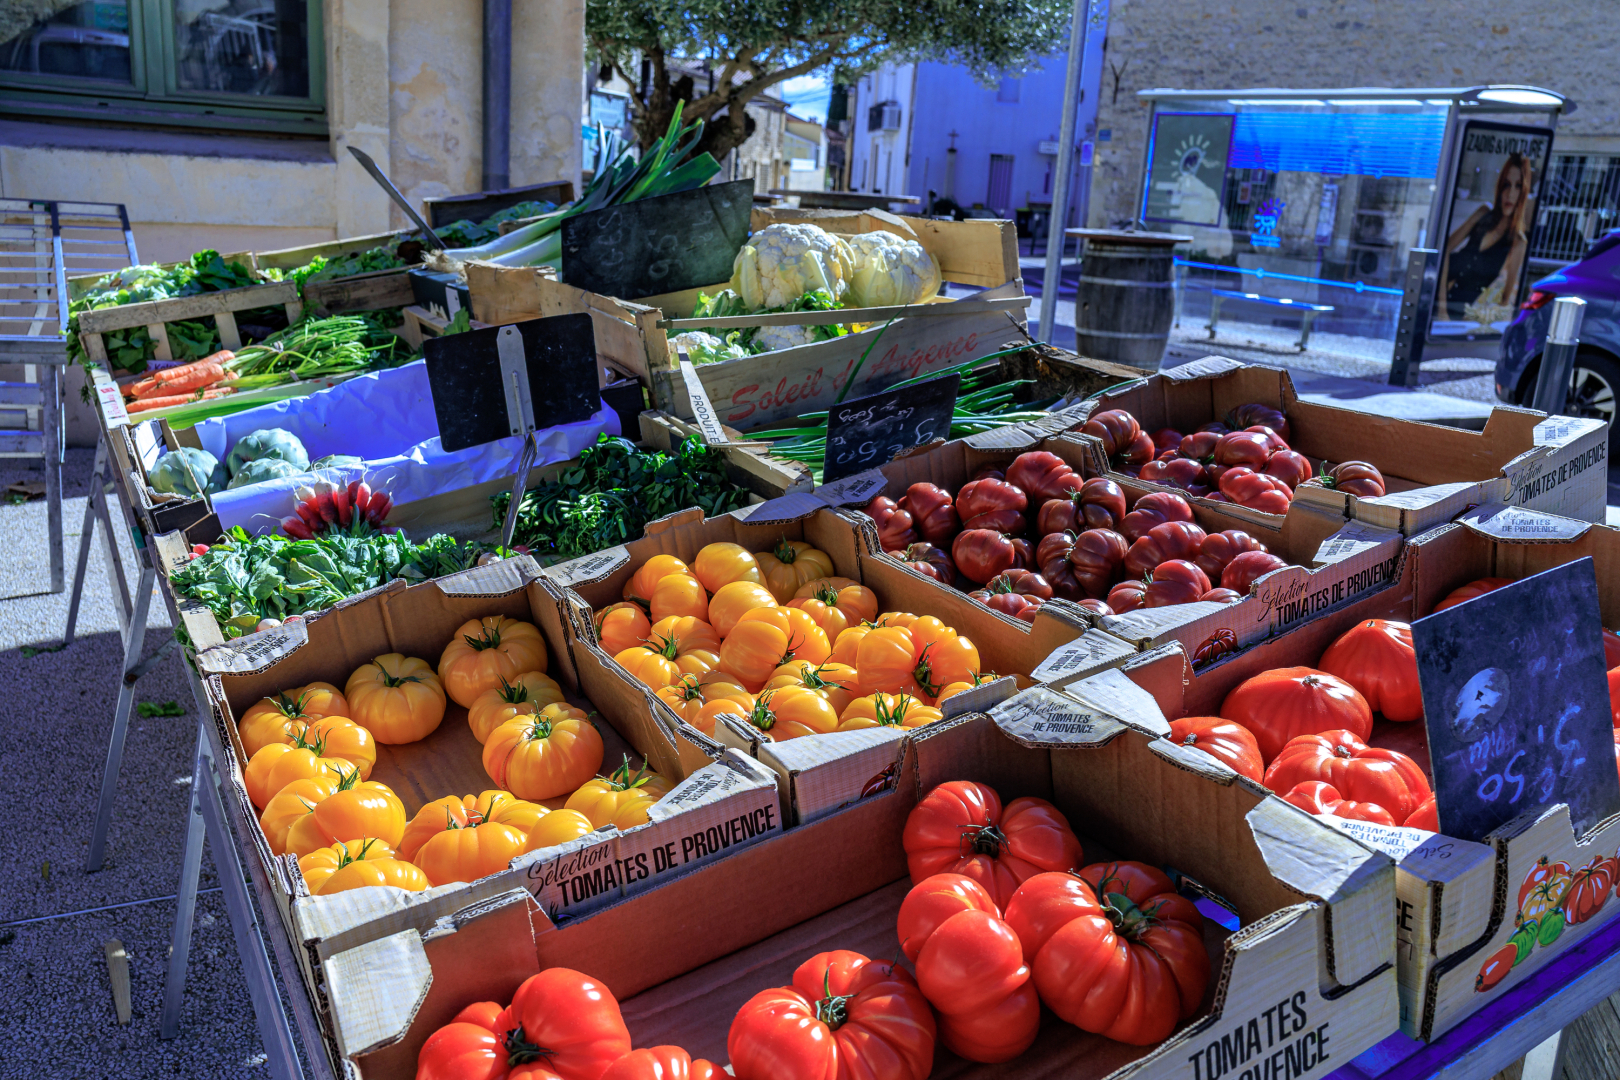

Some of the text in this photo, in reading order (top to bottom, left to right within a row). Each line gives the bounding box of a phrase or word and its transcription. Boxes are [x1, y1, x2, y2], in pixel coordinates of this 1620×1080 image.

[691, 394, 717, 436] PRODUIT
[728, 367, 823, 421] Soleil
[1518, 441, 1606, 506] TOMATES DE PROVENCE
[1514, 525, 1559, 533] PROVENCE
[1257, 578, 1309, 622] Sélection
[1276, 587, 1329, 627] TOMATES
[1331, 580, 1345, 604] DE
[1032, 721, 1096, 734] DE PROVENCE
[1046, 712, 1091, 724] TOMATES
[1340, 821, 1421, 842] DE PROVENCE
[1350, 830, 1407, 848] TOMATES
[527, 842, 611, 898] Sélection
[557, 803, 777, 908] TOMATES DE PROVENCE
[1188, 990, 1307, 1080] TOMATES
